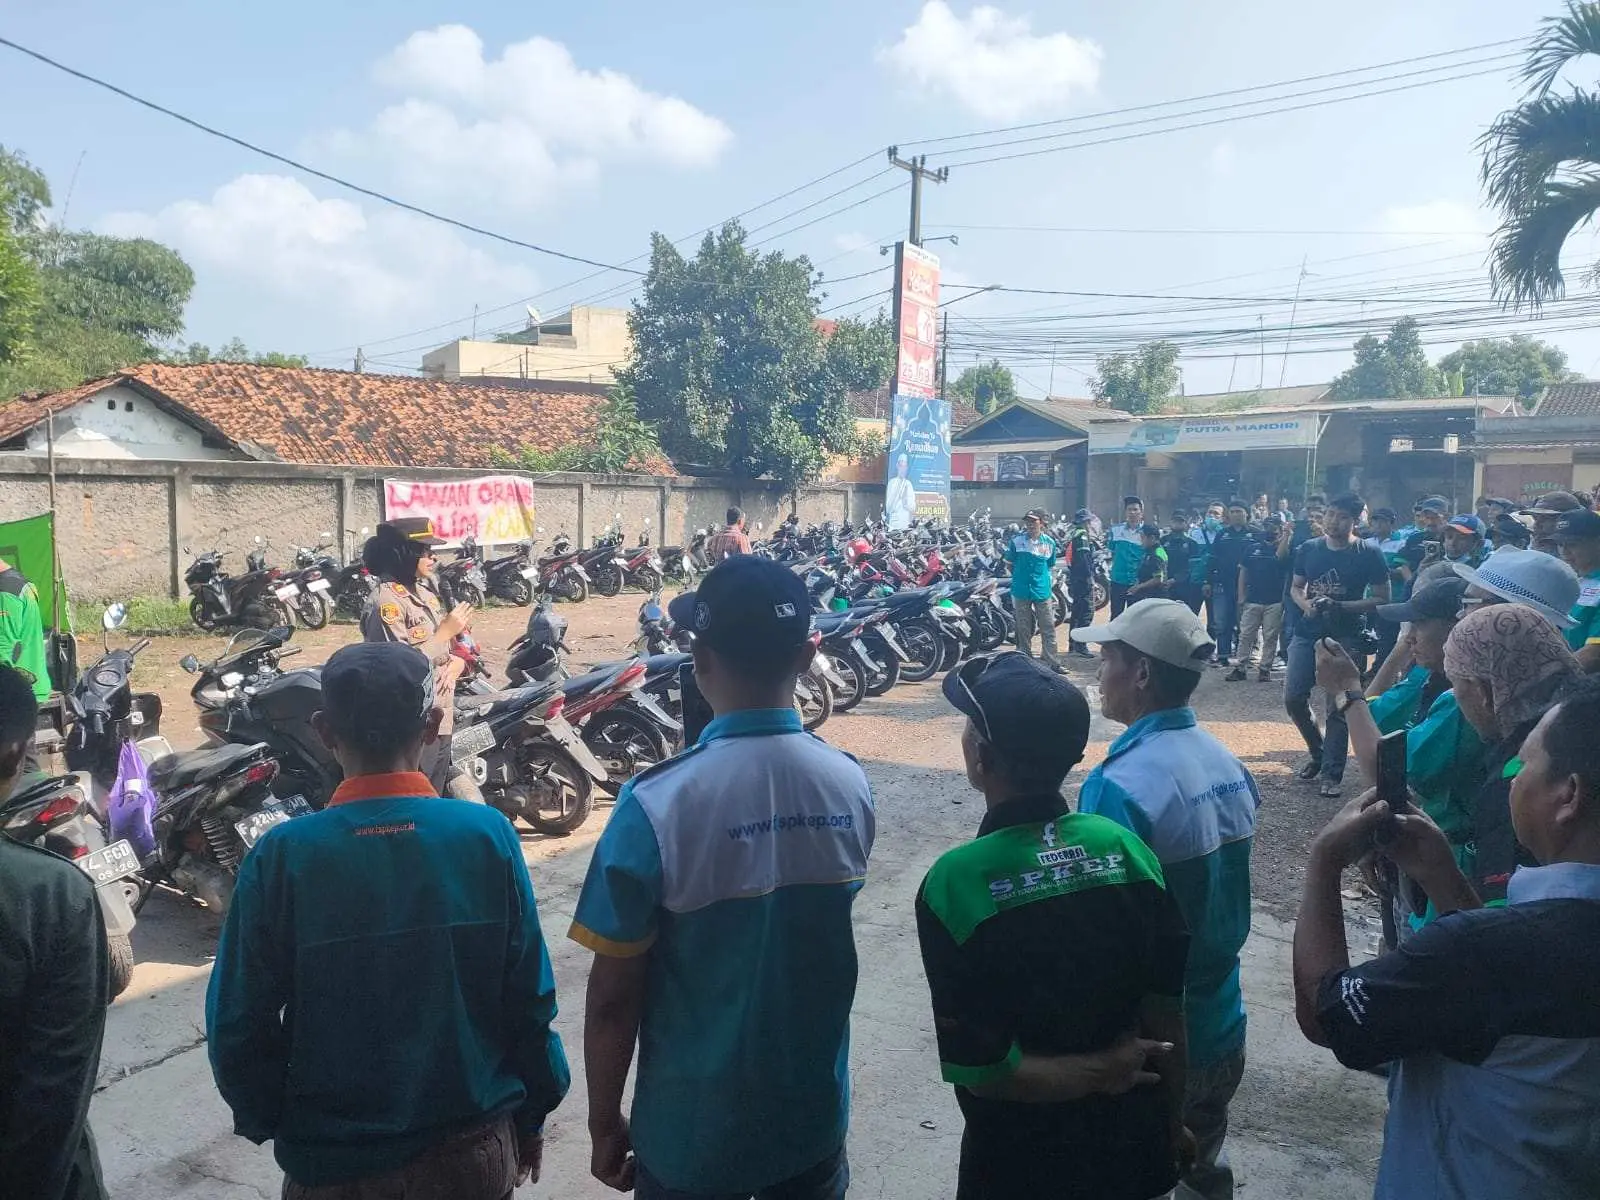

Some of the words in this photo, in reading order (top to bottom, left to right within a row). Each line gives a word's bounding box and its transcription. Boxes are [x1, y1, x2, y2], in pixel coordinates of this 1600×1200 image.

[1184, 426, 1230, 434] PUTRA
[1235, 421, 1299, 432] MANDIRI
[388, 483, 471, 507] LAWAN
[1040, 847, 1084, 865] FEDERASI
[988, 853, 1123, 897] SPKEP
